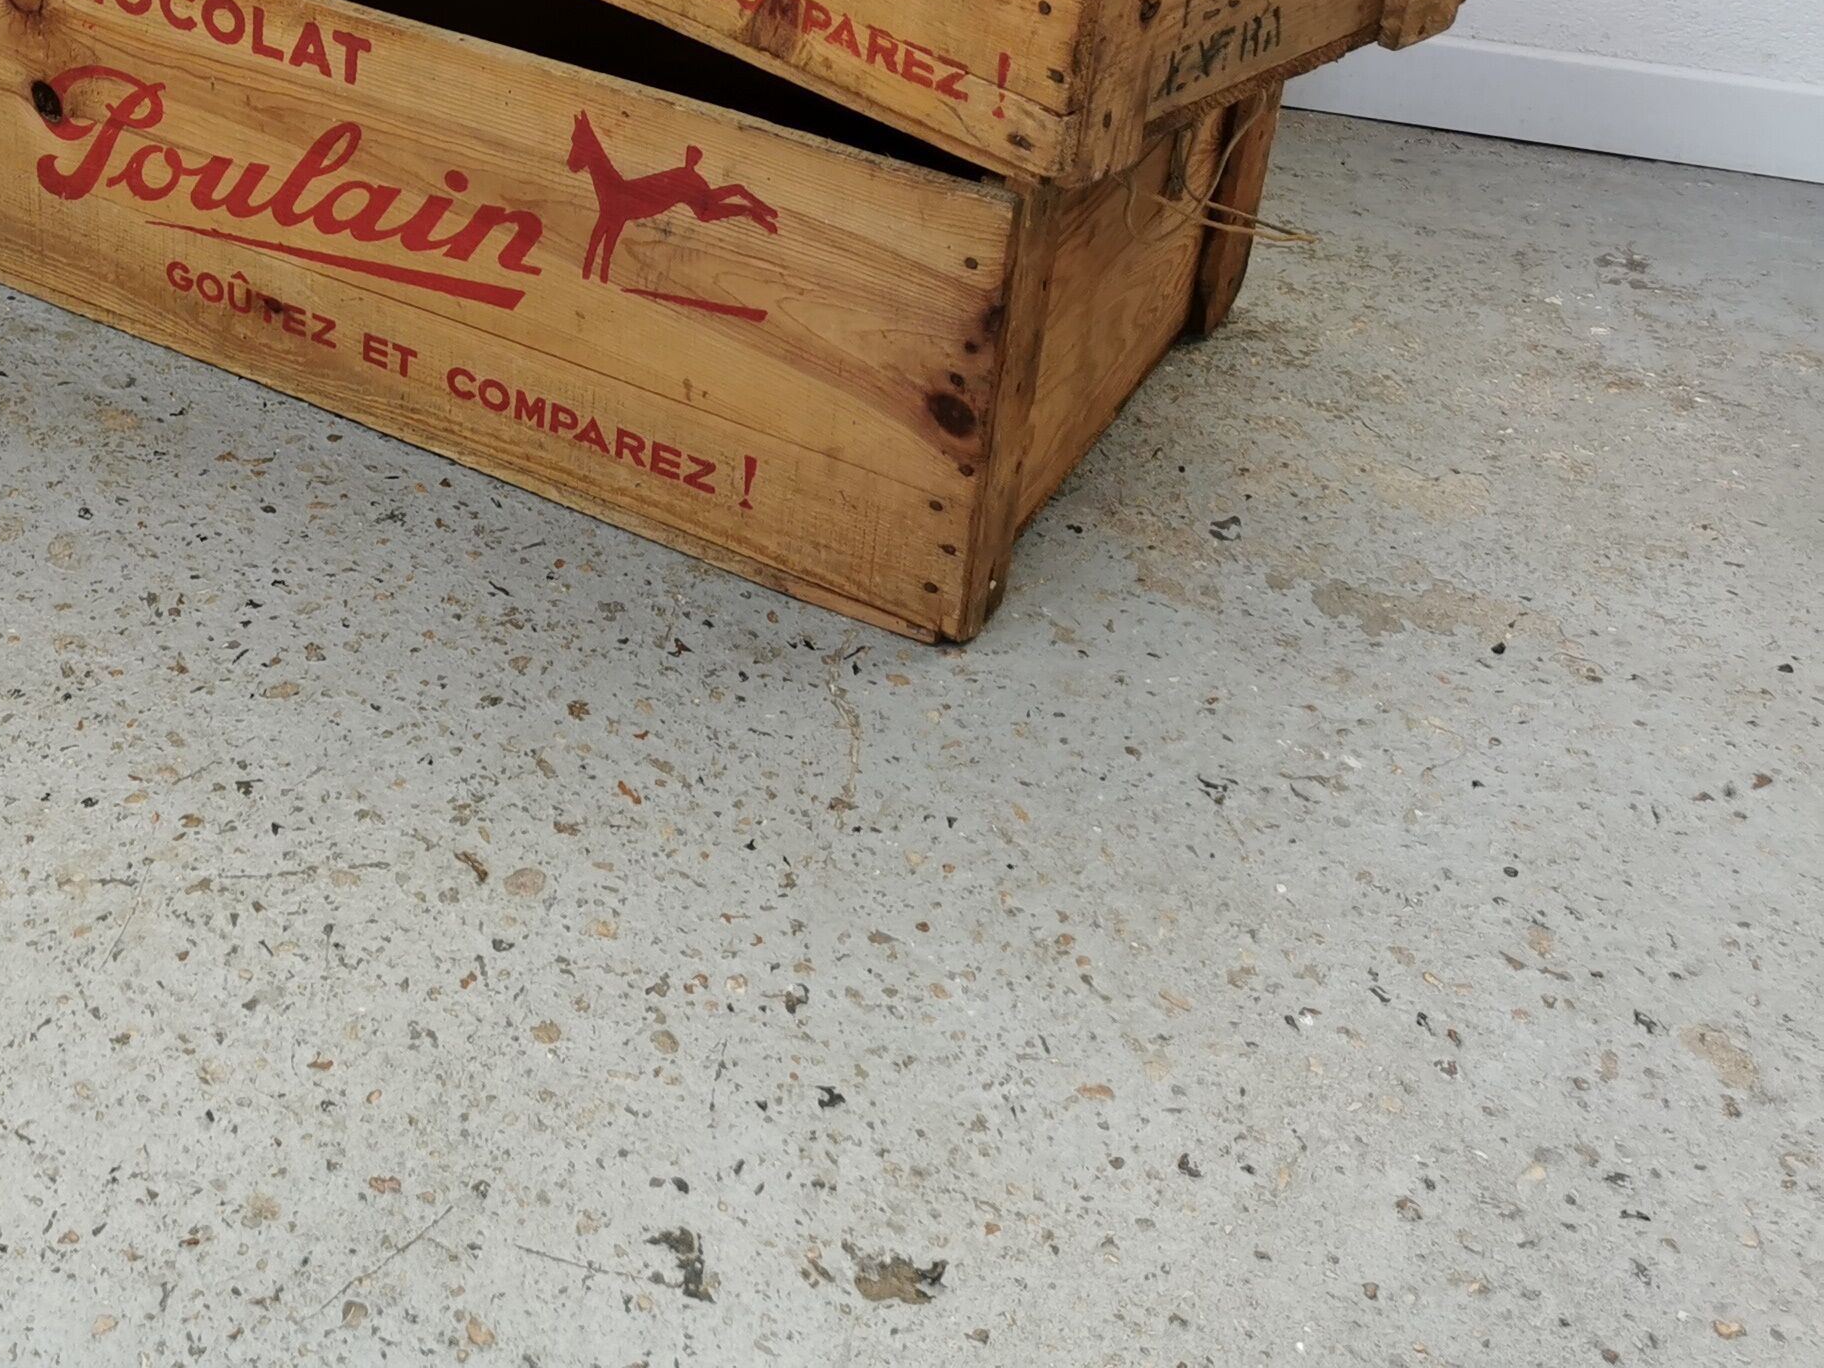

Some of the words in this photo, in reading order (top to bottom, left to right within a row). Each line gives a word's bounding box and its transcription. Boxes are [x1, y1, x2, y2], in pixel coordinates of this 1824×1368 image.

[36, 65, 543, 276] Poulain
[166, 260, 337, 350] GOÛTEZ
[362, 332, 417, 377] ET
[447, 365, 717, 496] COMPAREZ
